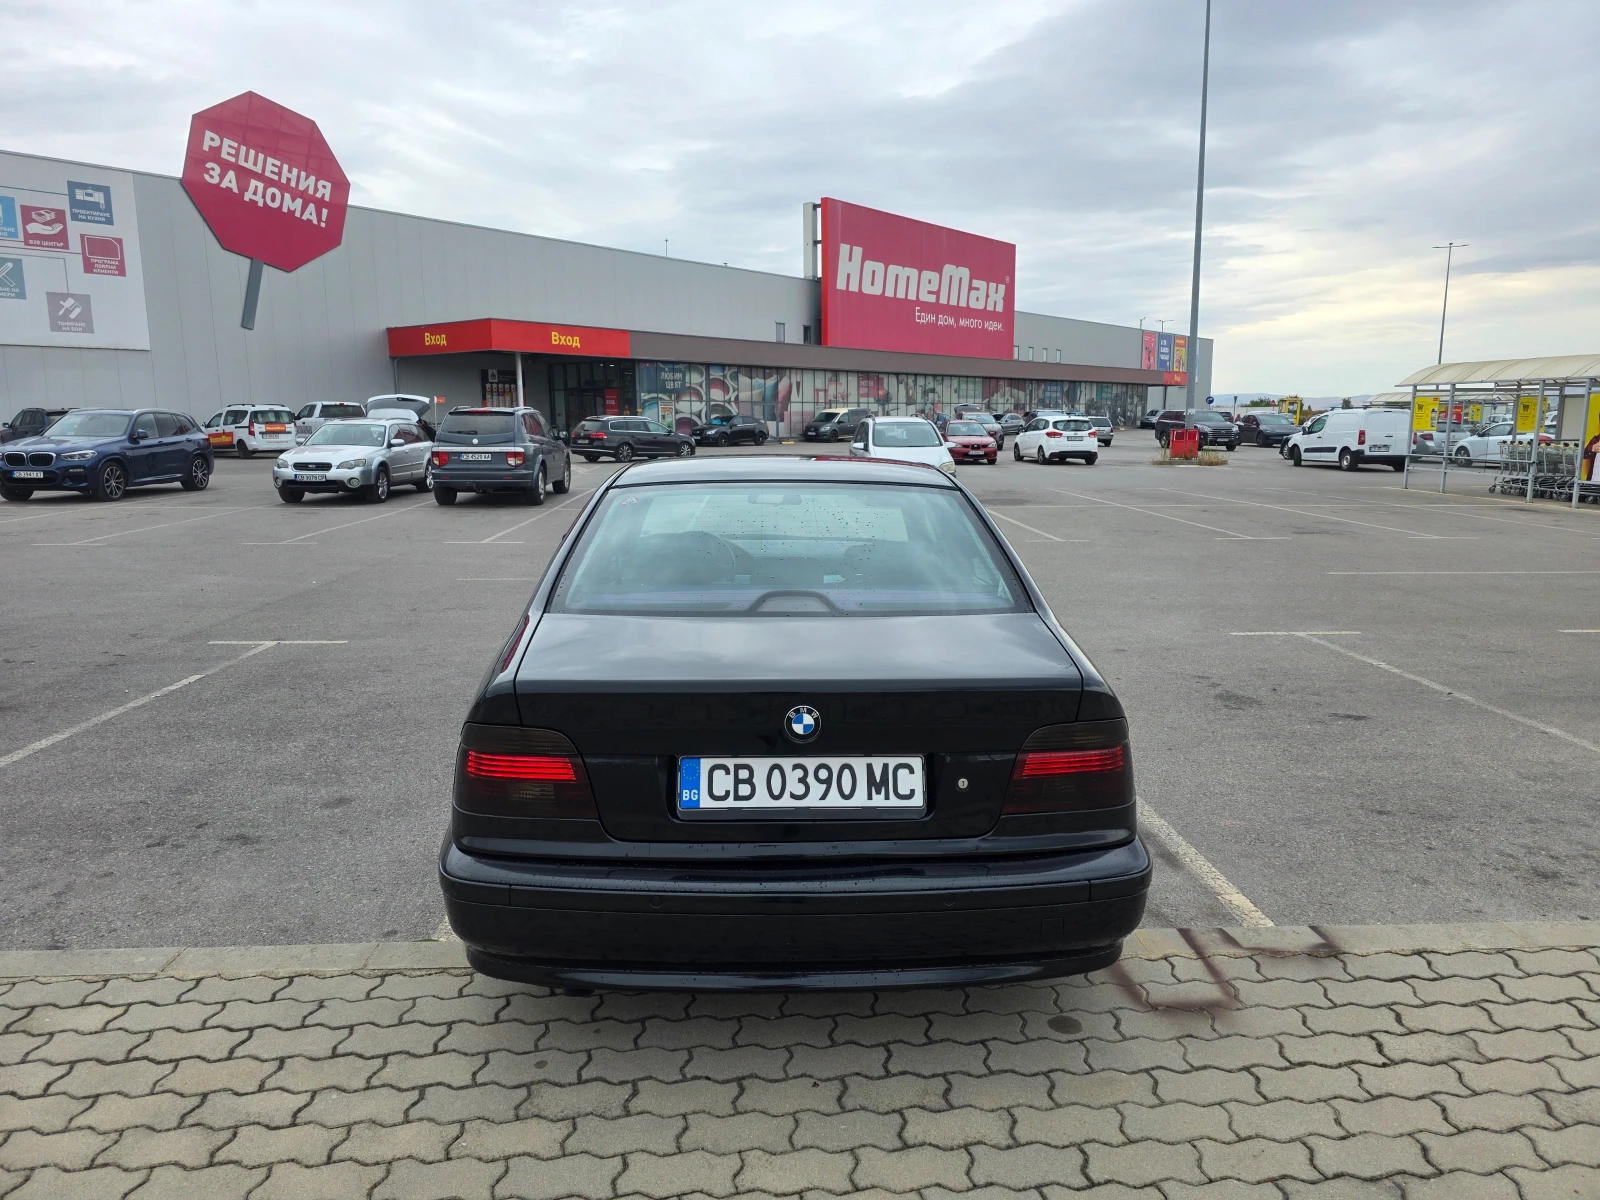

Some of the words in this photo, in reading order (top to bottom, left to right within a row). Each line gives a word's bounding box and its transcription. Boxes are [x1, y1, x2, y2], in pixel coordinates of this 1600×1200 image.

[202, 130, 332, 202] РЕШЕНИЯ
[203, 162, 239, 194] ЗА
[244, 178, 329, 228] ДОМА!
[72, 208, 111, 218] ПРОЕКТИРАНЕ
[41, 240, 64, 248] ЦЕНТЪР
[90, 258, 119, 266] ПРОГРАМА
[836, 243, 1006, 313] HomeMax
[57, 320, 87, 328] ТОНИРАНЕ
[915, 307, 936, 324] Един
[938, 314, 957, 328] дом,
[959, 317, 983, 329] много
[984, 319, 1005, 332] идеи.
[424, 332, 447, 347] Вход
[551, 332, 581, 348] Вход
[660, 371, 683, 380] ЛЮБИМ
[665, 381, 682, 389] ЦВЯТ
[789, 707, 819, 719] BMW
[707, 763, 757, 802] CB
[766, 763, 857, 801] 0390
[866, 762, 915, 801] MC
[682, 789, 699, 801] BG
